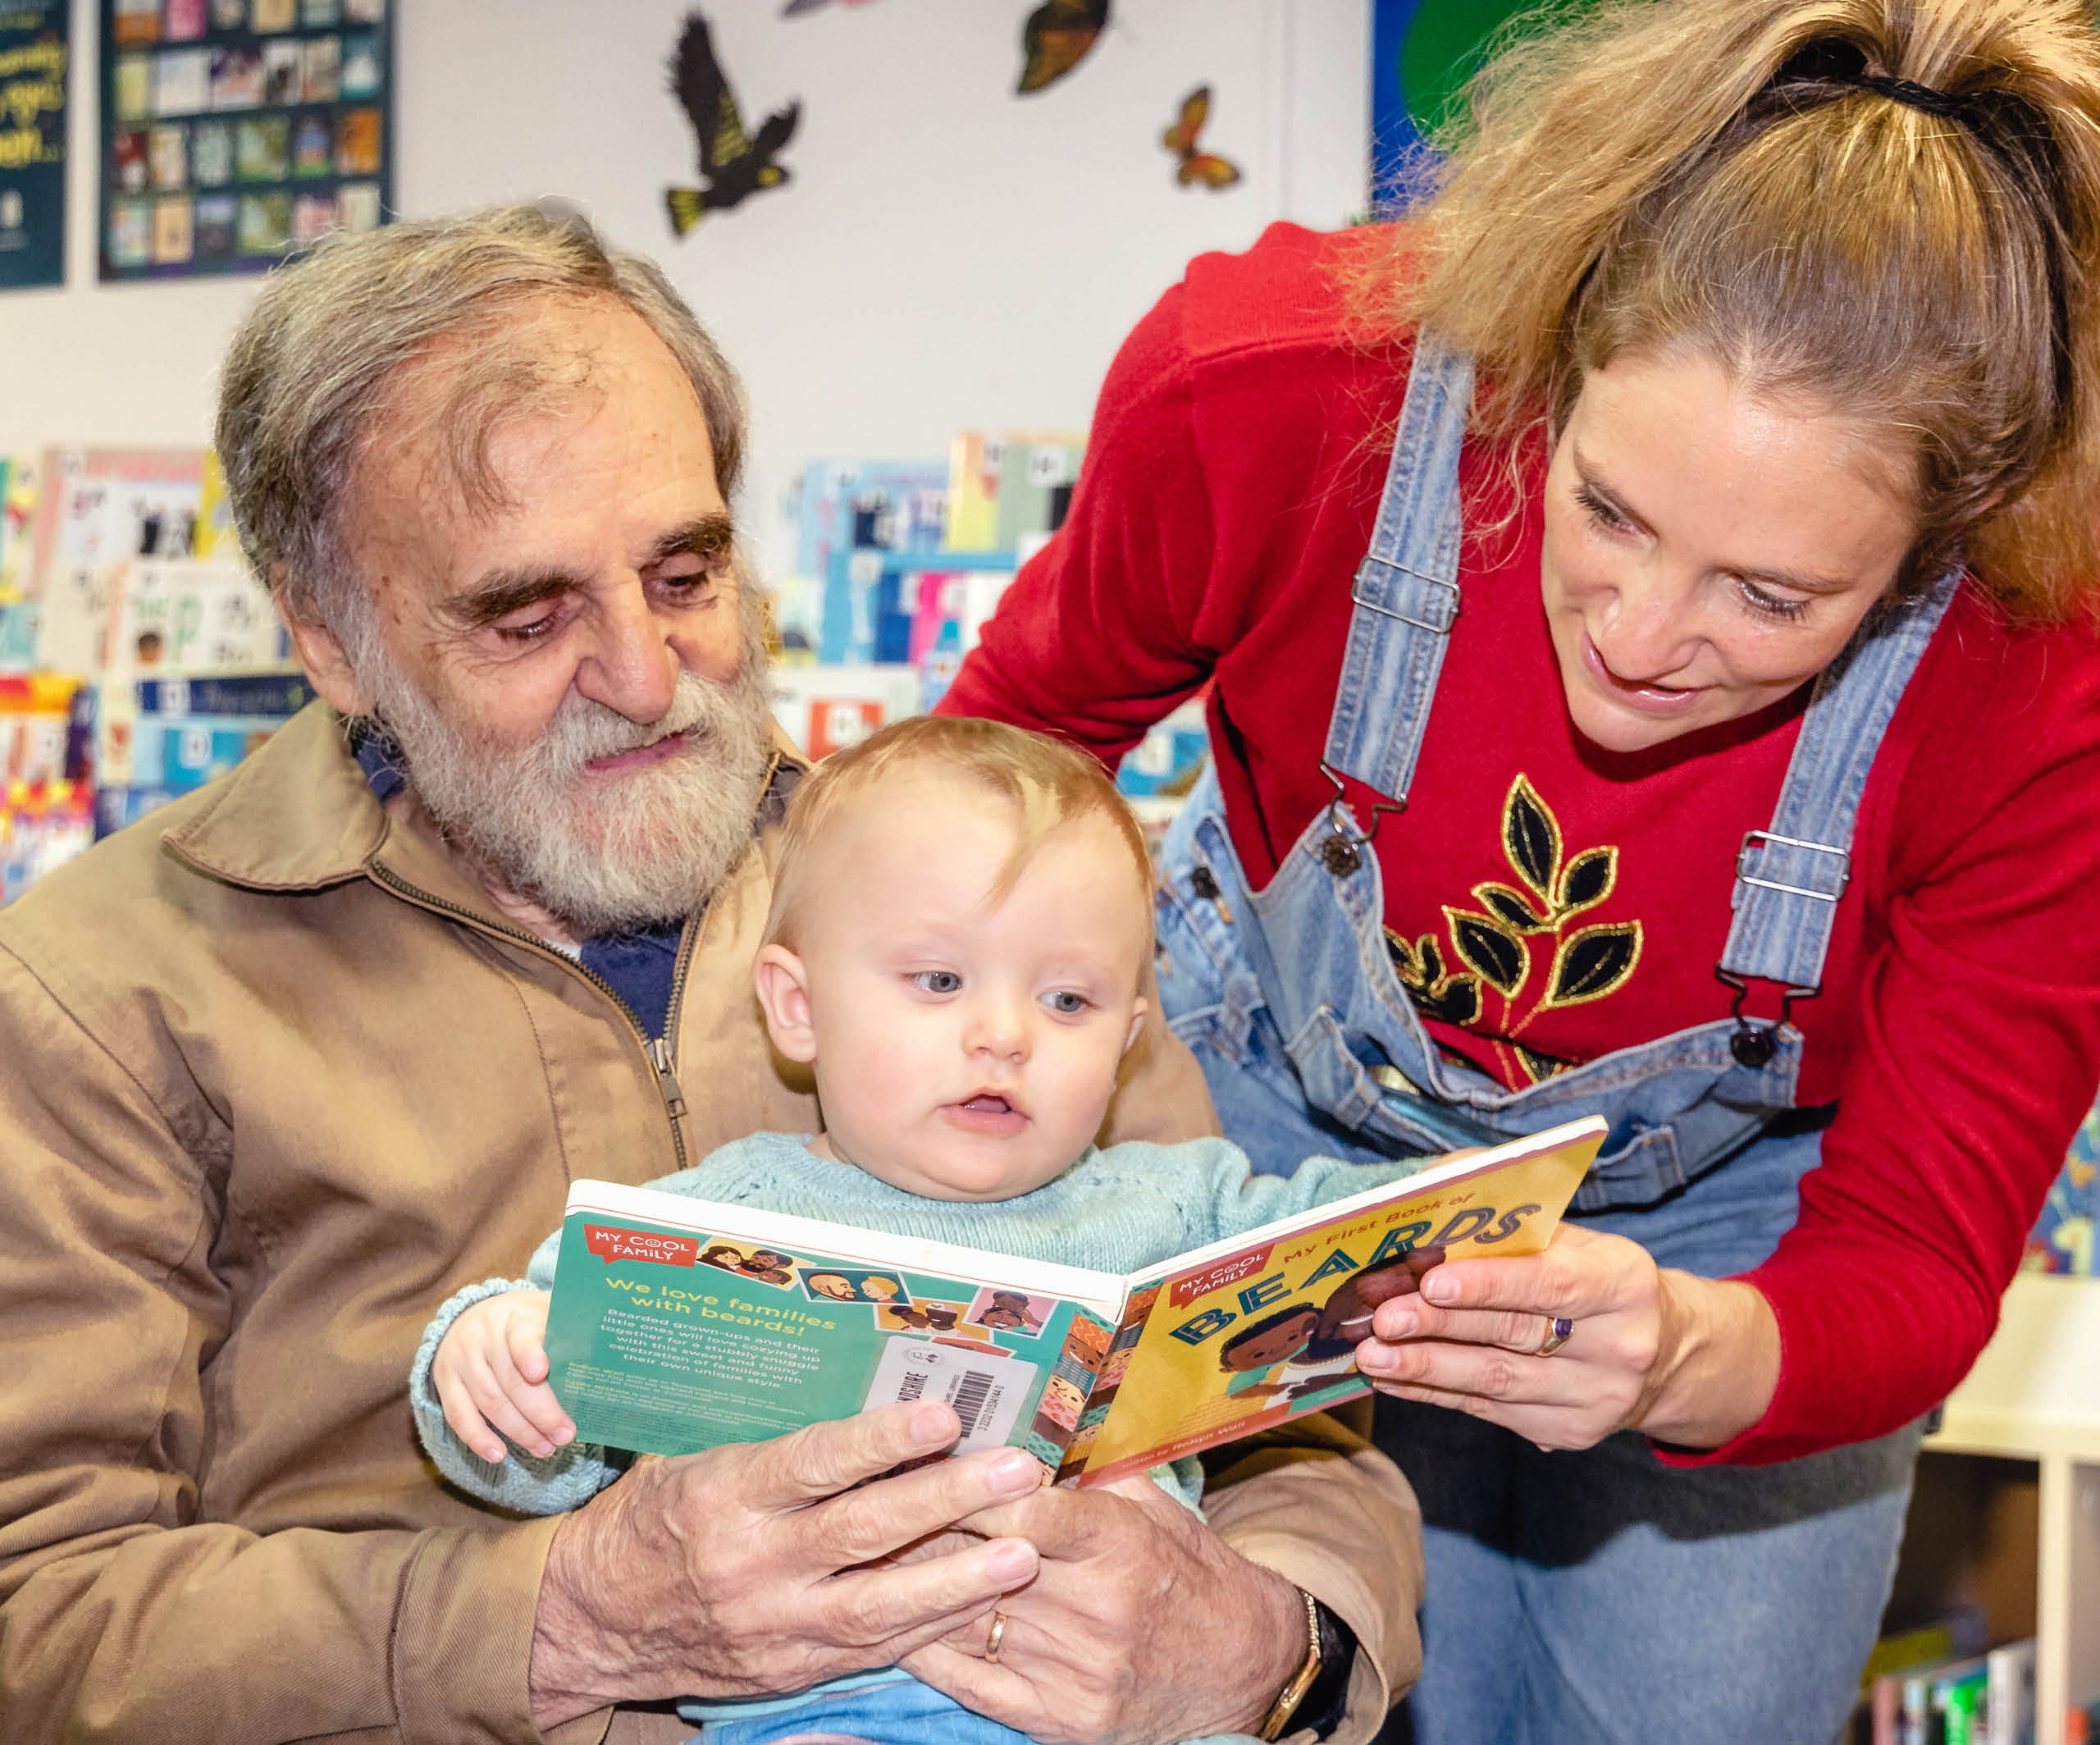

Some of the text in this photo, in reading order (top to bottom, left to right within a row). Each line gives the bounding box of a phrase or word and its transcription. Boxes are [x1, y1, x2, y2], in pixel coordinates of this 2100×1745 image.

[1386, 1200, 1441, 1224] Book
[1449, 1192, 1477, 1206] of
[596, 1231, 690, 1252] MY COOL
[1168, 1204, 1542, 1346] BEARDS
[1180, 1254, 1264, 1292] MY COOL
[605, 1277, 838, 1331] We love families
[631, 1296, 806, 1336] with beards!
[600, 1324, 664, 1341] together
[667, 1336, 688, 1345] for
[705, 1344, 759, 1359] stubbly
[762, 1355, 819, 1371] snuggle
[603, 1316, 820, 1363] little ones will love cozying up
[608, 1309, 820, 1354] Bearded grown-ups and their
[609, 1343, 690, 1363] celebration
[713, 1363, 768, 1377] families
[772, 1374, 802, 1385] with
[616, 1336, 800, 1376] with this sweet and funny
[623, 1353, 656, 1364] their
[660, 1361, 691, 1372] own
[695, 1368, 742, 1382] unique
